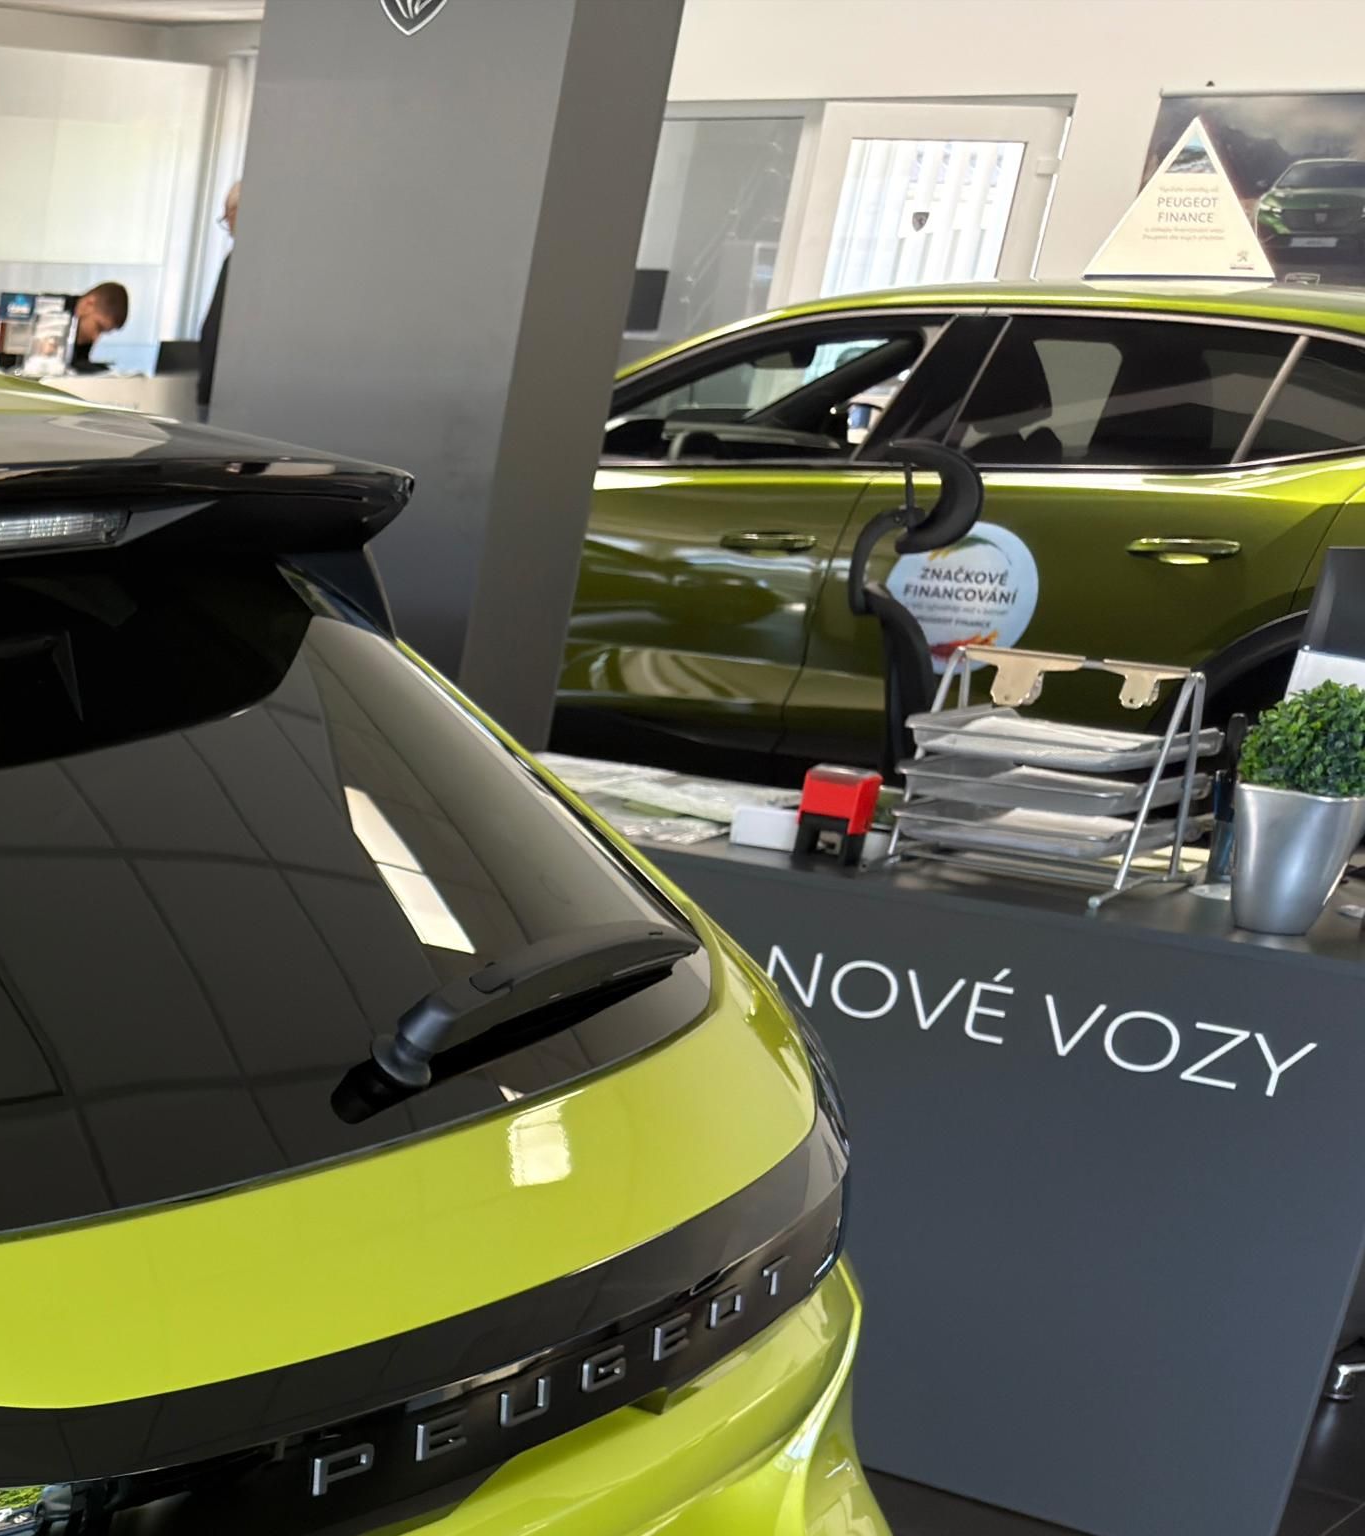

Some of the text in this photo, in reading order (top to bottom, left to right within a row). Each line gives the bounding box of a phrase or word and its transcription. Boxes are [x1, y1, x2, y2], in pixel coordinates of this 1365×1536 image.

[1157, 196, 1219, 208] PEUGEOT
[1157, 211, 1215, 223] FINANCE
[920, 566, 1010, 586] ZNAČKOVÉ
[903, 584, 1018, 605] FINANCOVÁNÍ
[768, 944, 1318, 1098] NOVÉ VOZY
[312, 1255, 791, 1497] PEUGEOT
